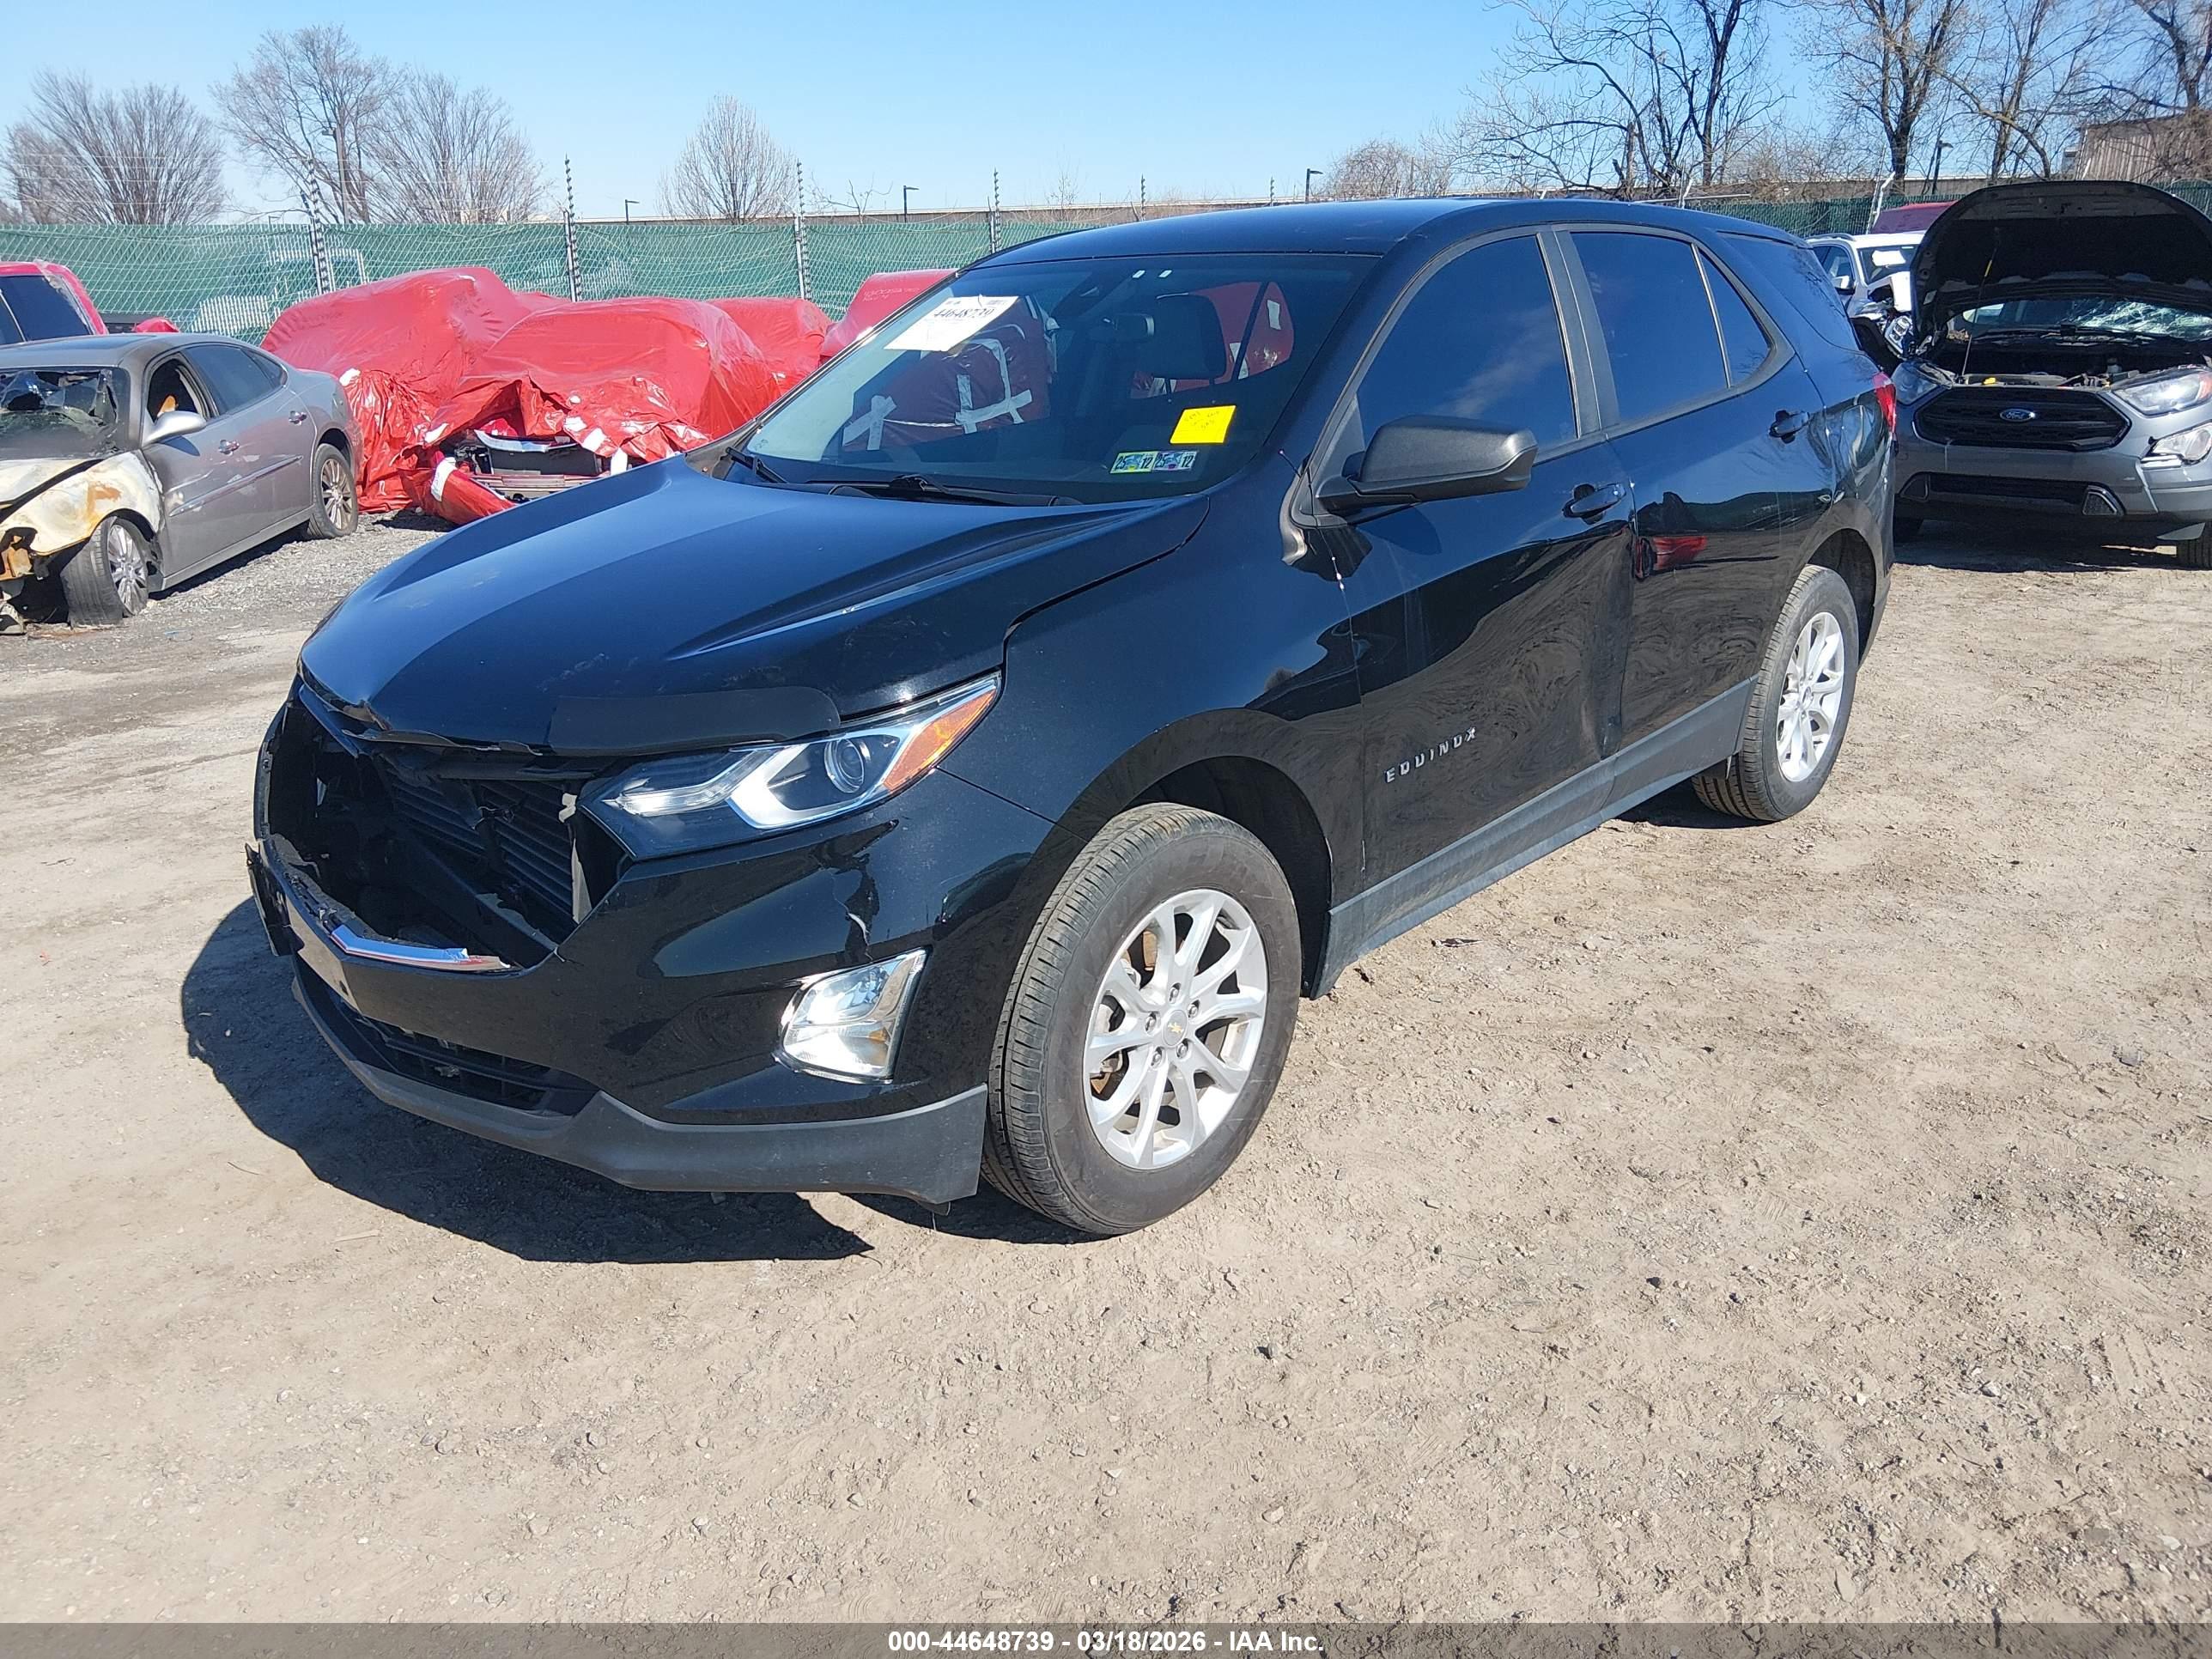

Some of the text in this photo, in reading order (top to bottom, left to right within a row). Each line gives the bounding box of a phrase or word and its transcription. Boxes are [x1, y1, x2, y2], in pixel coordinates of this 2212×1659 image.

[1115, 455, 1153, 470] 25 12
[1154, 453, 1194, 468] 25 12
[1385, 726, 1476, 783] EQUINOX
